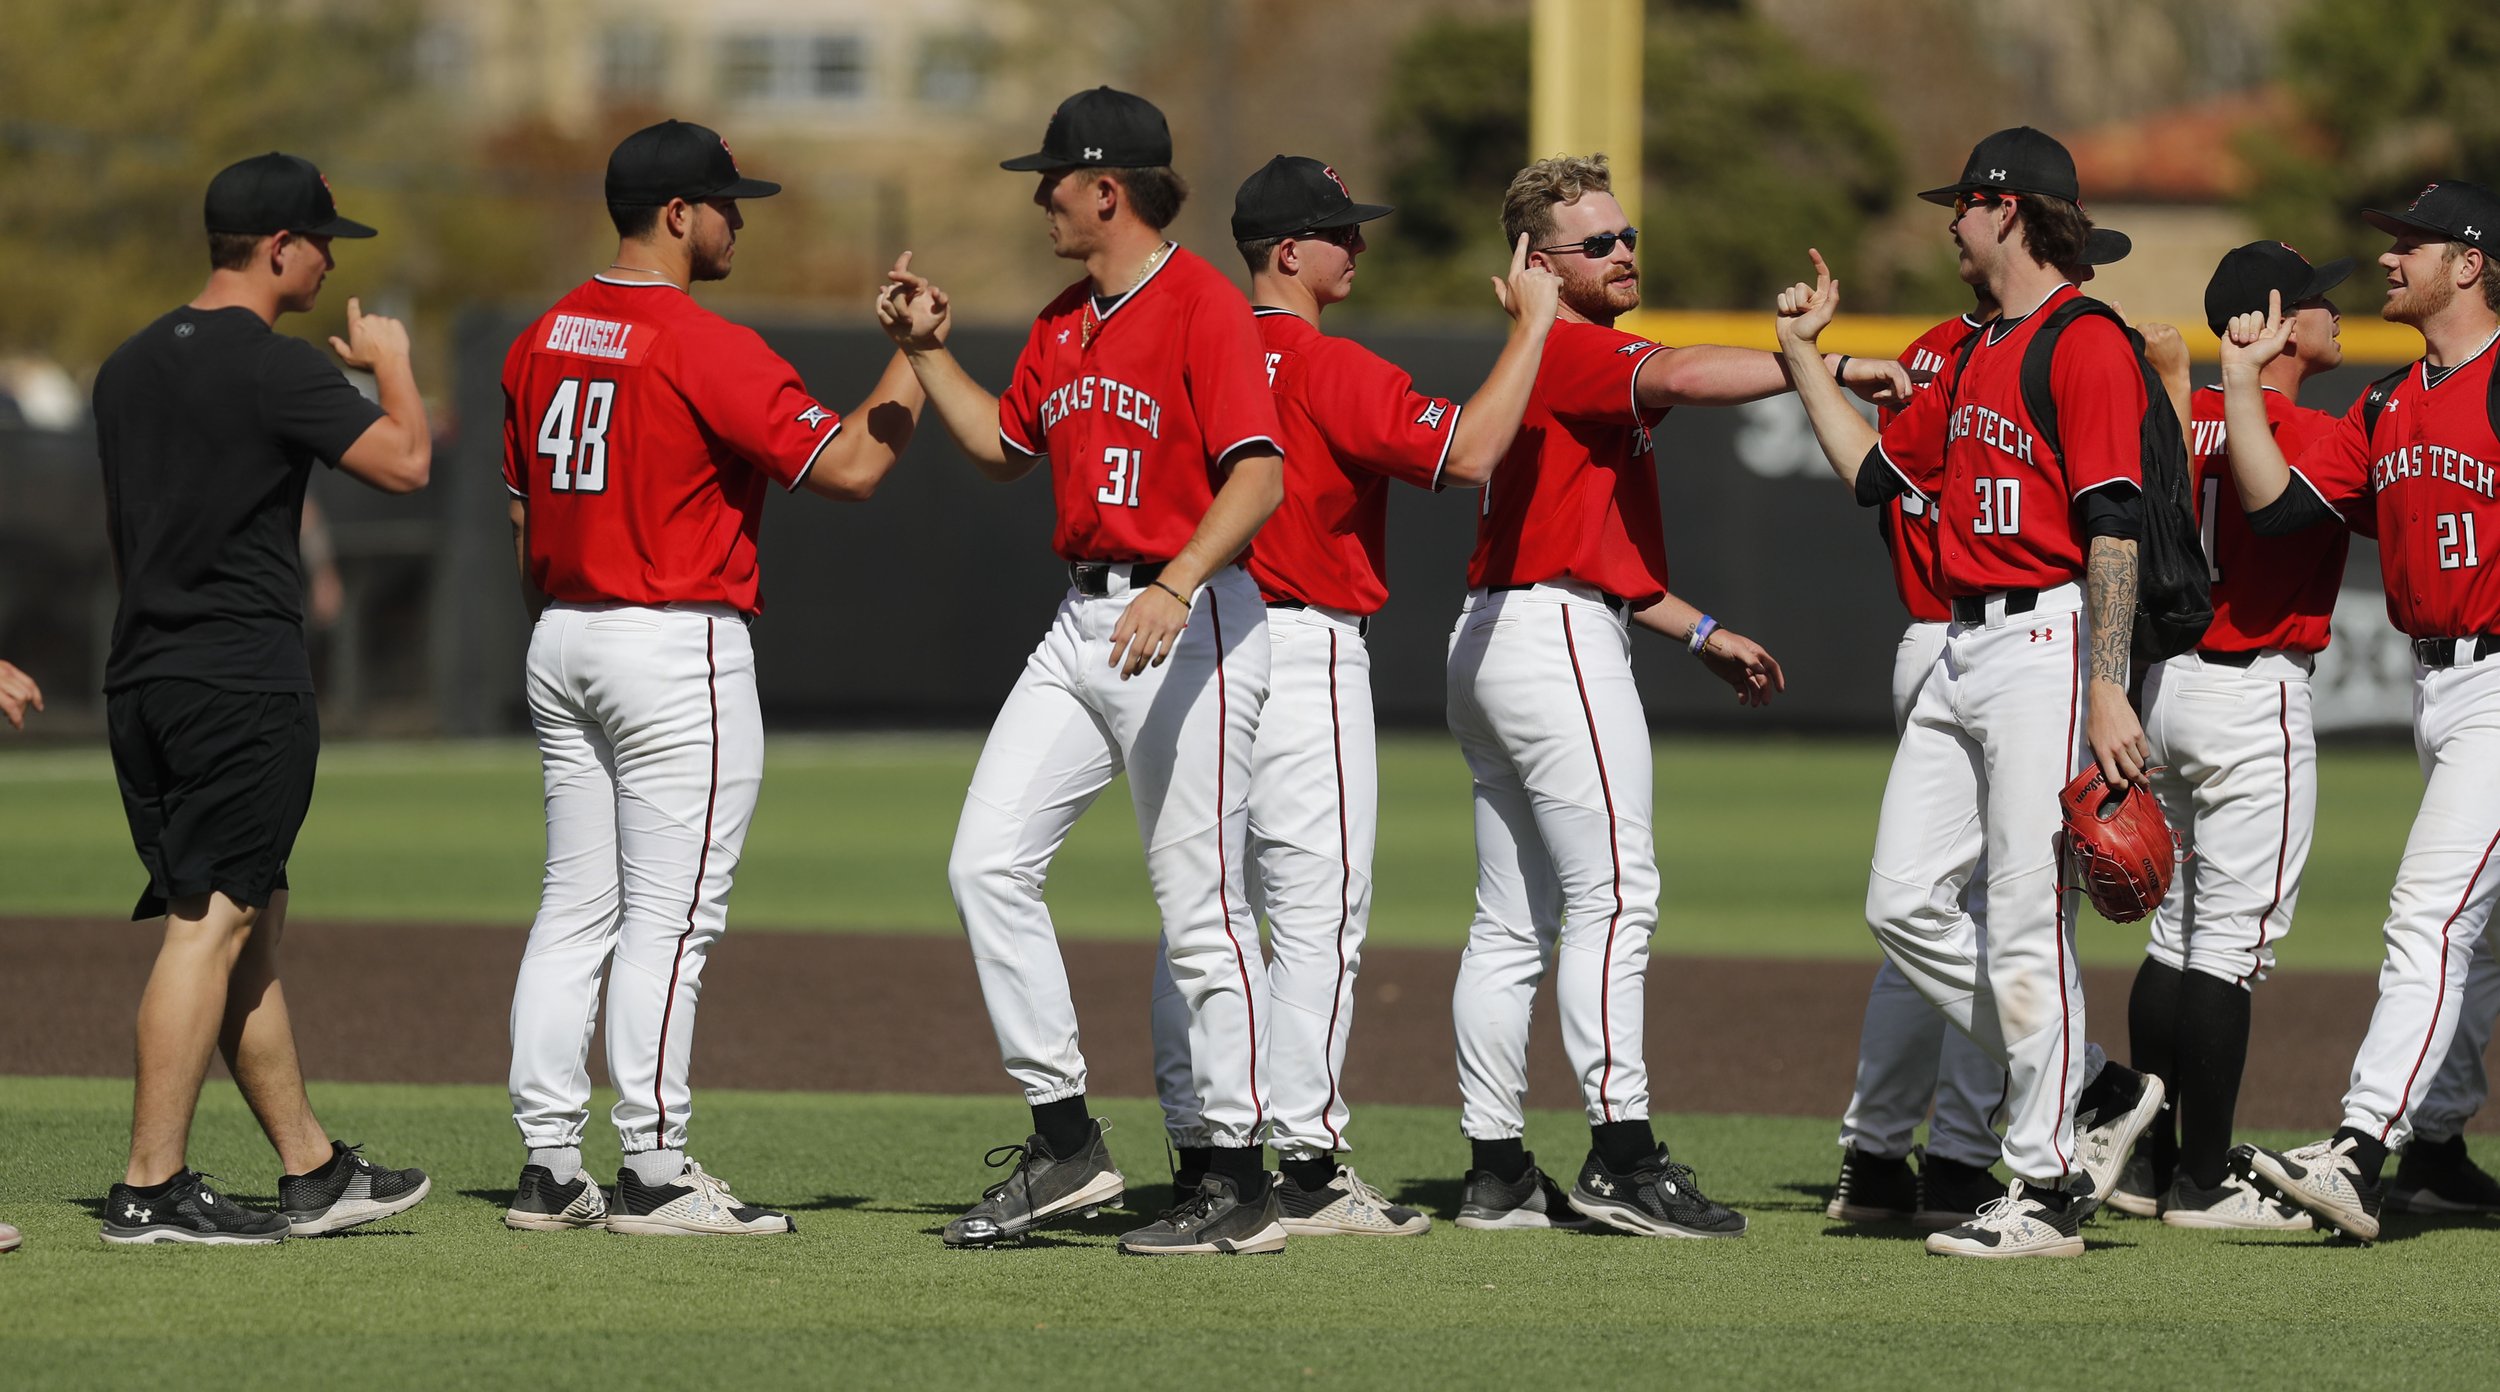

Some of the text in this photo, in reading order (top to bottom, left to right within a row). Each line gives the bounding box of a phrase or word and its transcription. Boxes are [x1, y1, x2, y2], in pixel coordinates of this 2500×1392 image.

[546, 314, 633, 360] BIRDSELL
[537, 378, 616, 493] 48
[1040, 375, 1161, 439] TEXAS TECH
[1976, 406, 2034, 466] TECH
[1098, 447, 1142, 507] 31
[2428, 445, 2496, 498] TECH
[1973, 477, 2020, 534] 30
[2437, 512, 2478, 569] 21
